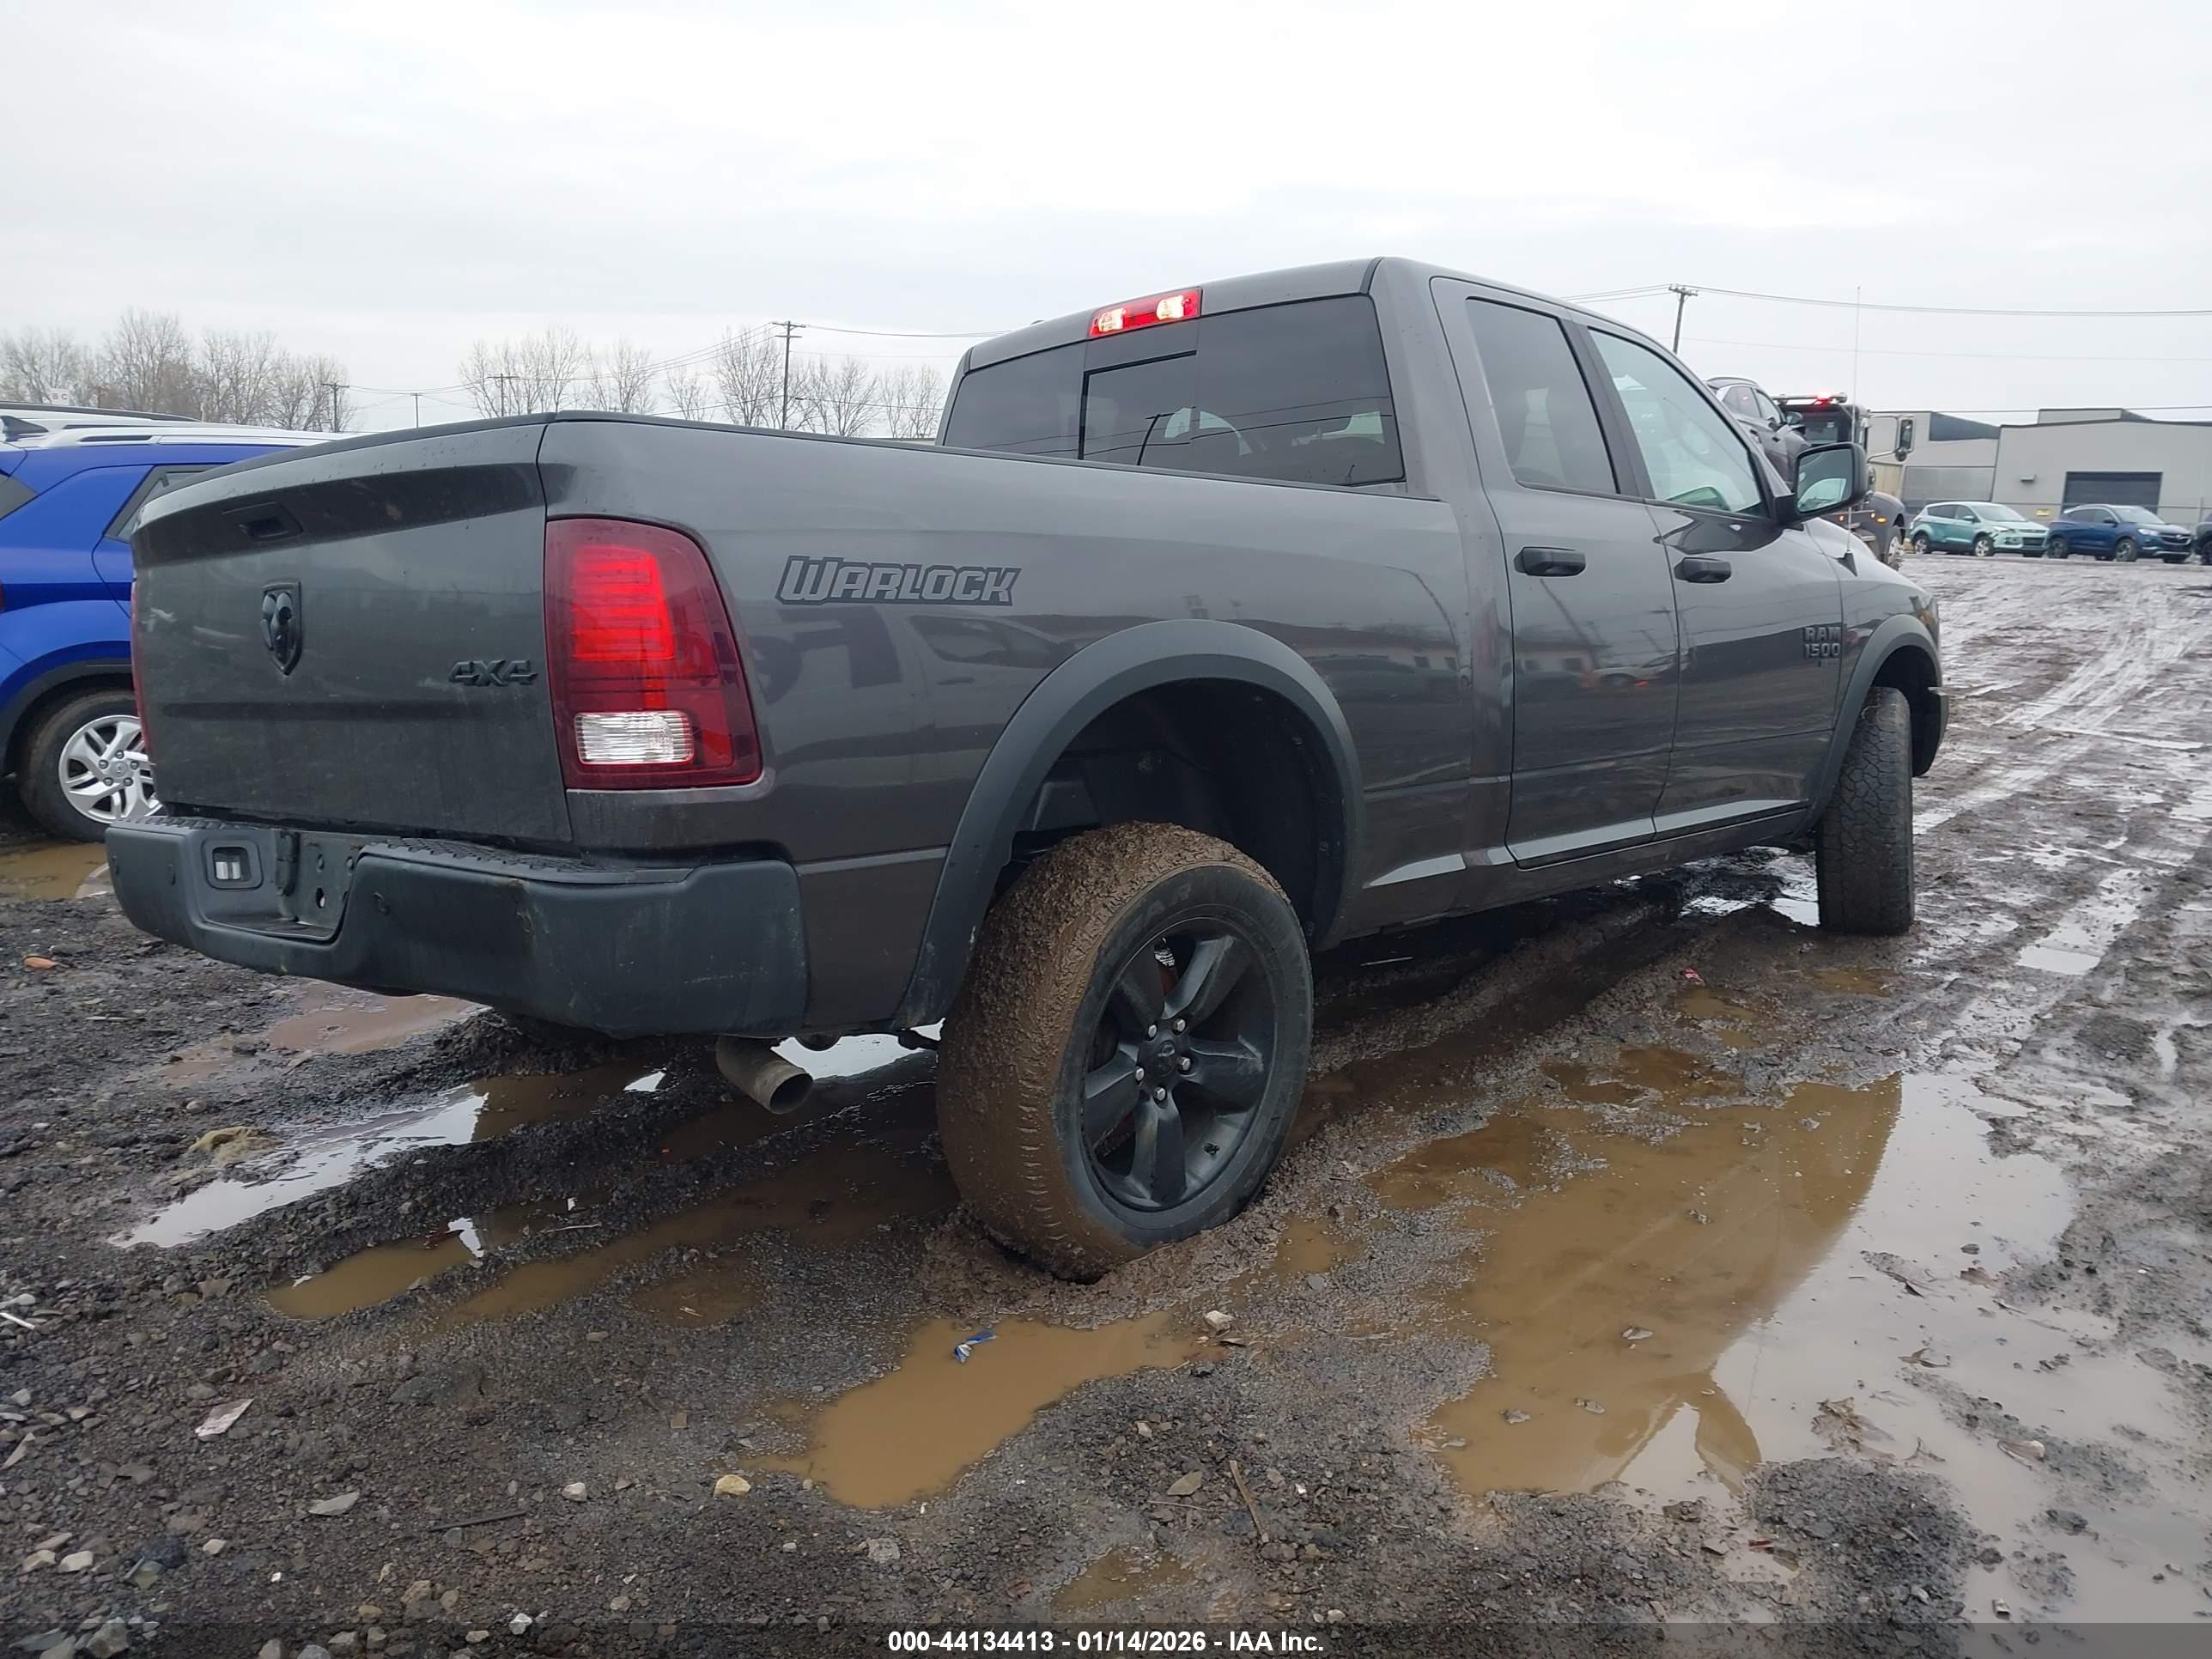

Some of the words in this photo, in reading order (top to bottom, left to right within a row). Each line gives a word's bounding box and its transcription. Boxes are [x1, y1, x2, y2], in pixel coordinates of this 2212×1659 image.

[775, 556, 1022, 605] WARLOCK
[1804, 627, 1841, 641] RAM
[1804, 642, 1841, 659] 1500
